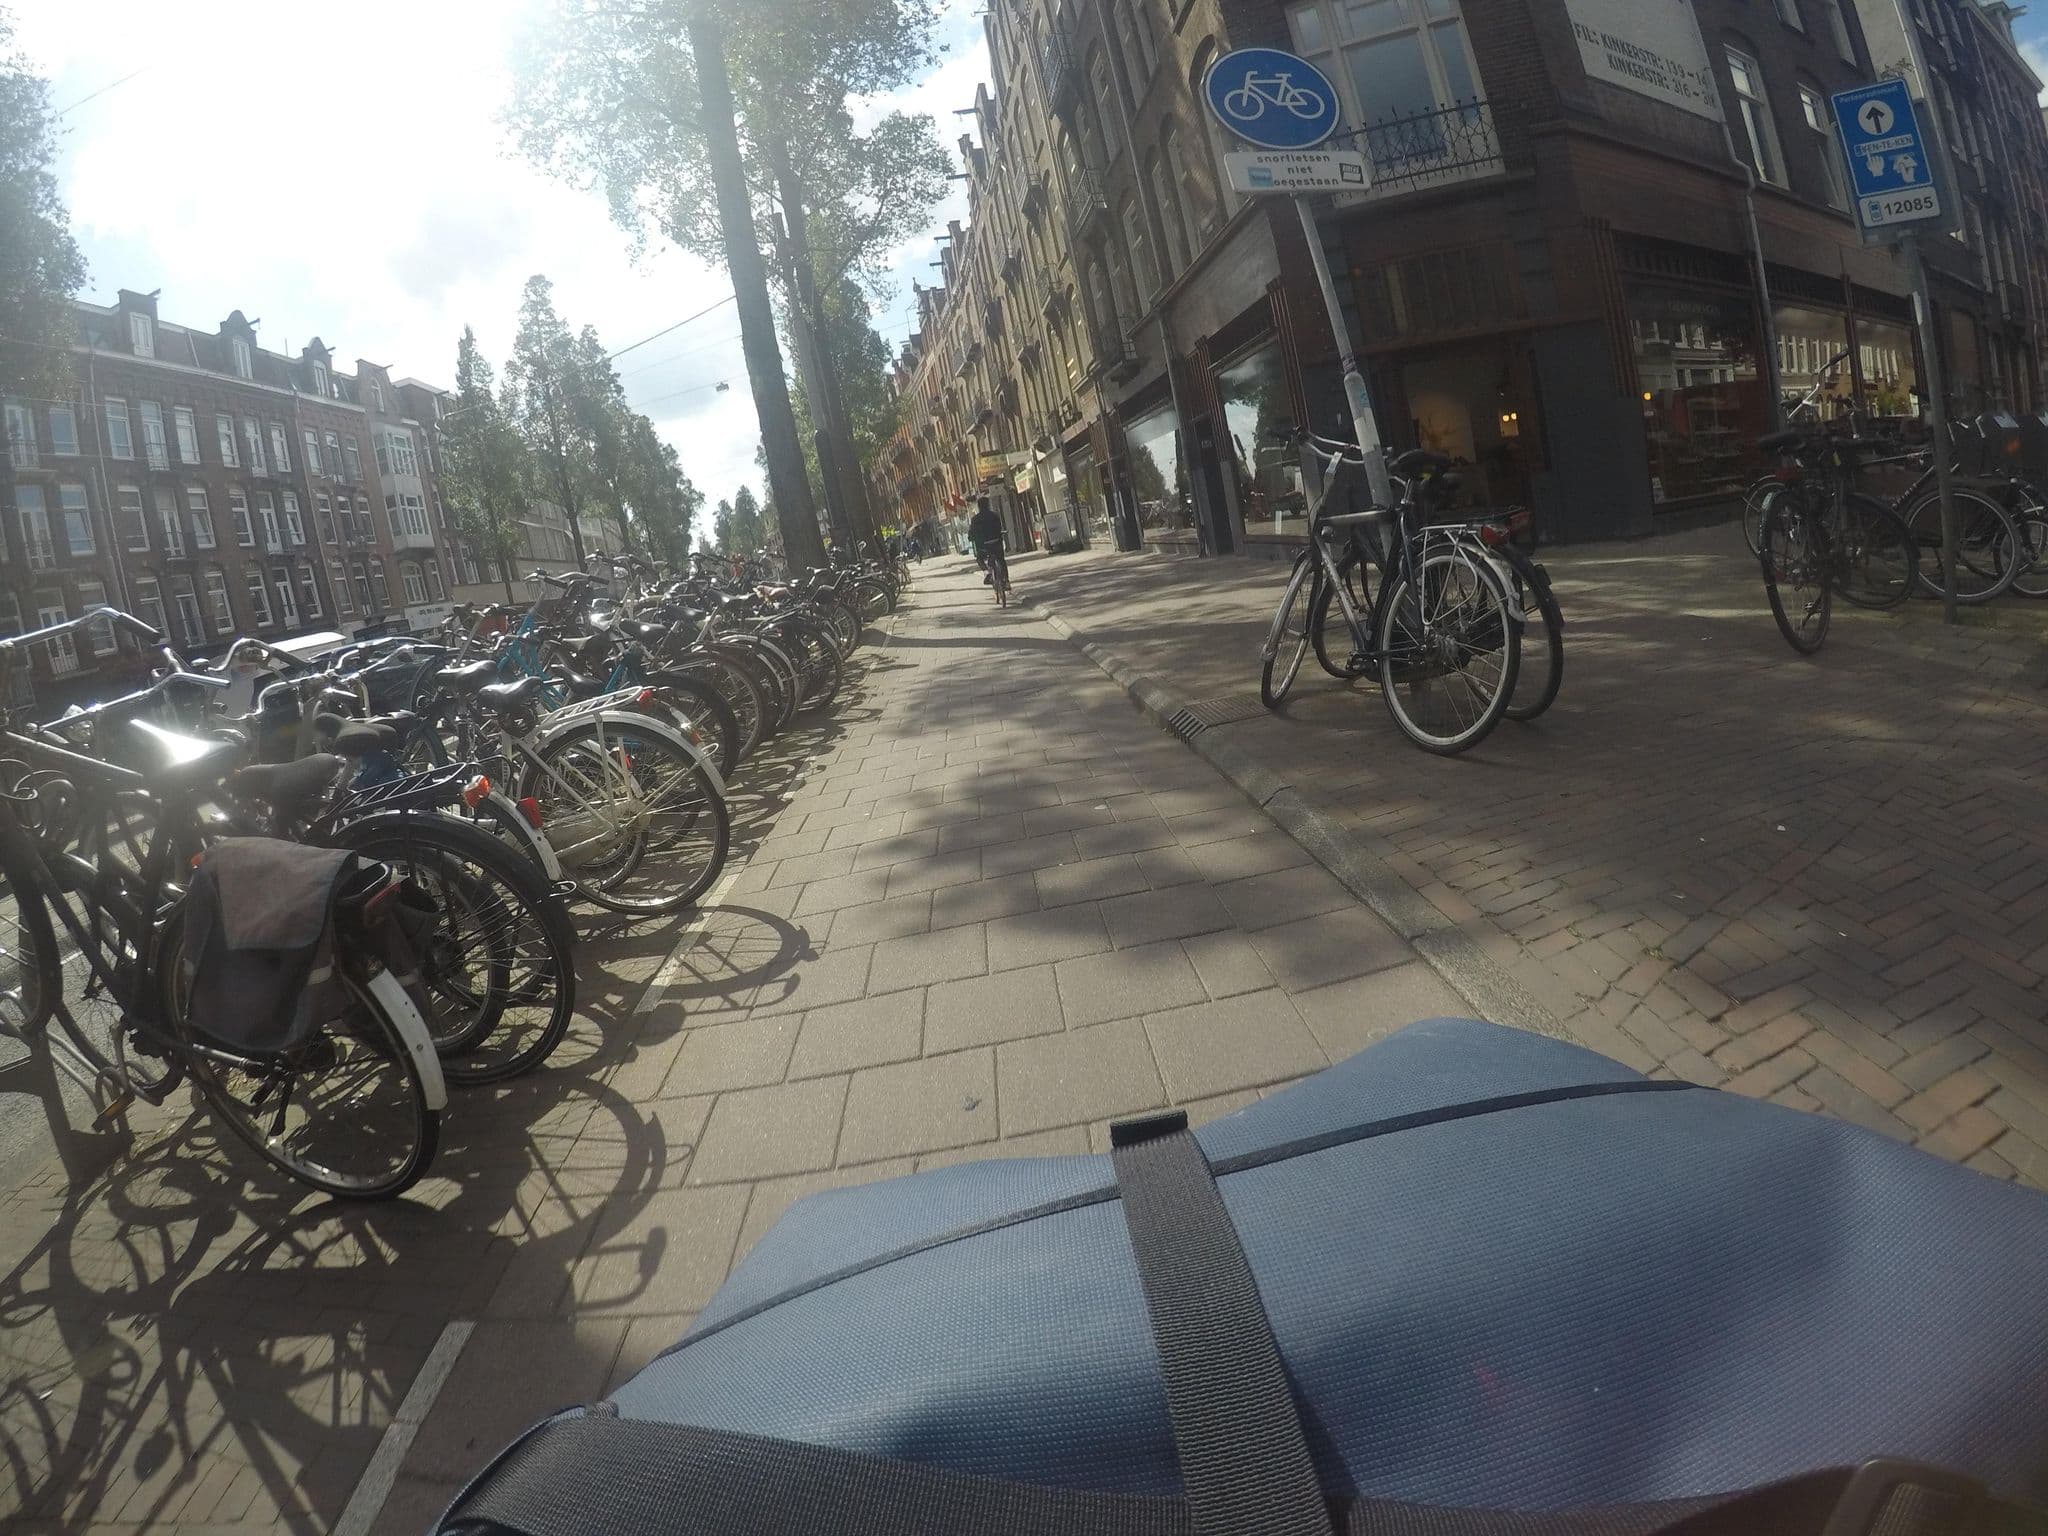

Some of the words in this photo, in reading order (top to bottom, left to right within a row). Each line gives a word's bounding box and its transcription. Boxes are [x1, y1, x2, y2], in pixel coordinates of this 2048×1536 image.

[1257, 154, 1330, 163] snorfietsen
[1287, 165, 1313, 174] niet
[1271, 177, 1339, 187] oegestaan
[1884, 196, 1933, 216] 12085
